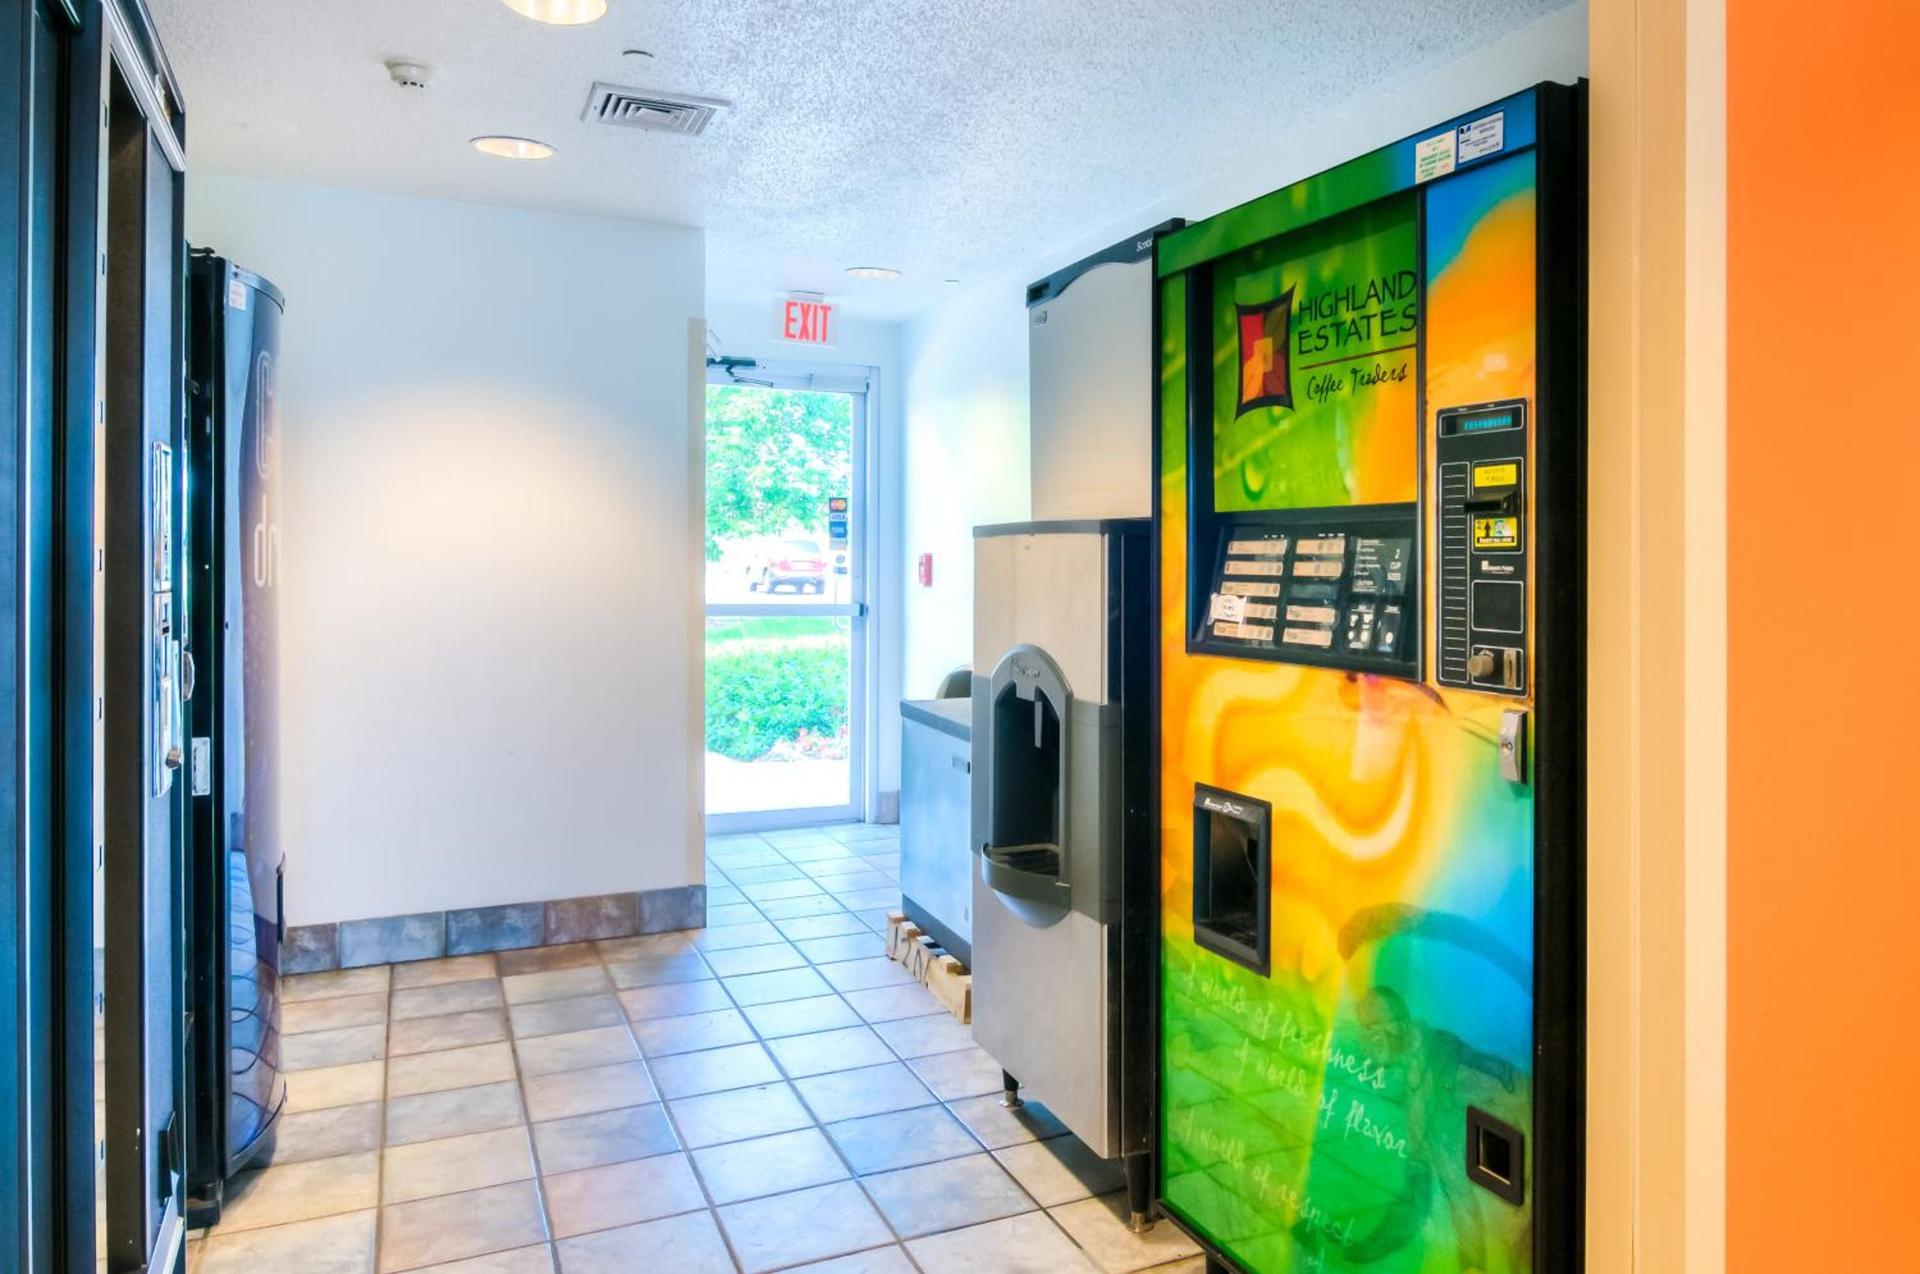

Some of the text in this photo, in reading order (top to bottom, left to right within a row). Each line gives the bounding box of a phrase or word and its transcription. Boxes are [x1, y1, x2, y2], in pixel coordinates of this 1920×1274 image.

[1299, 270, 1418, 324] HIGHLAND
[783, 300, 832, 343] EXIT
[1298, 303, 1418, 355] ESTATES
[1307, 363, 1408, 404] Coffee Traders
[1255, 1001, 1275, 1040] of
[1316, 1088, 1338, 1130] of
[1343, 1099, 1408, 1159] flavor
[1252, 1162, 1273, 1199] of
